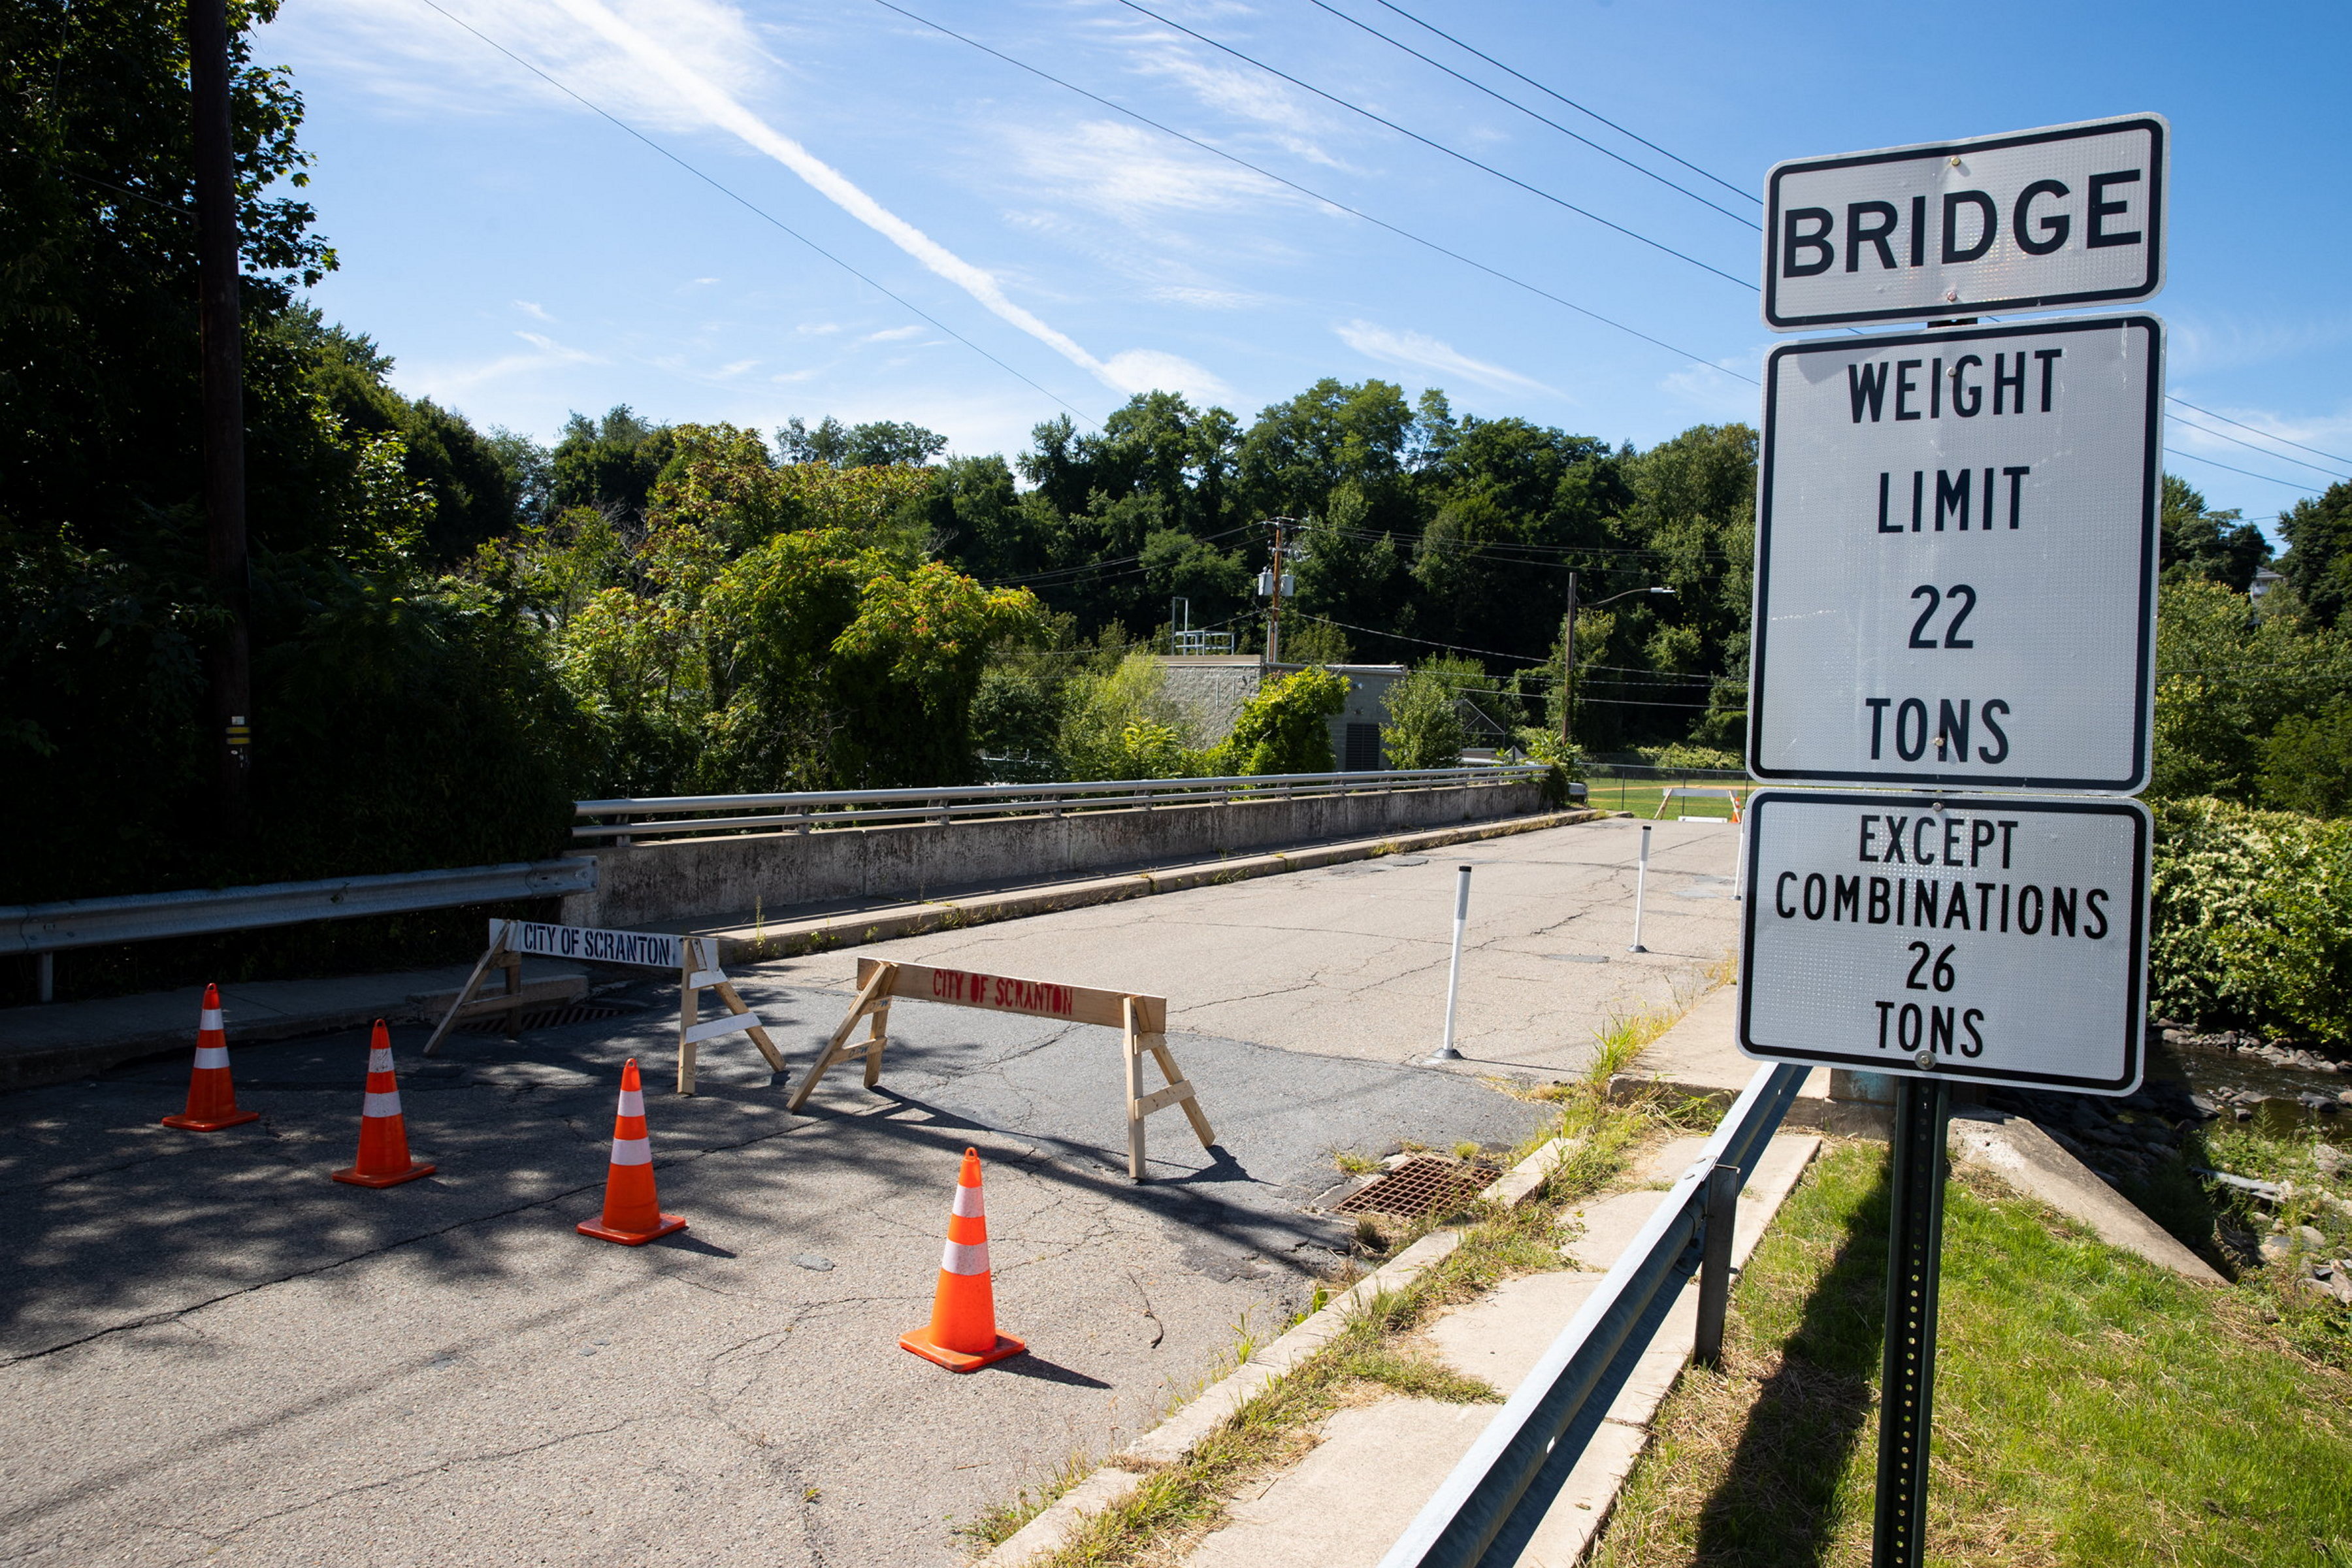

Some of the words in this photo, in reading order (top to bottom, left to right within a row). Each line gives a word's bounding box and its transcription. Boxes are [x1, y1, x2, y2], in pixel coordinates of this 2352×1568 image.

[1783, 169, 2142, 278] BRIDGE
[1848, 349, 2063, 423] WEIGHT
[1878, 466, 2029, 533] LIMIT
[1908, 585, 1976, 648] 22
[1865, 698, 2010, 764] TONS
[1859, 815, 2018, 868] EXCEPT
[1776, 872, 2109, 939] COMBINATIONS
[524, 924, 556, 952] CITY
[561, 928, 580, 955] OF
[585, 931, 670, 966] SCRANTON
[1906, 941, 1955, 992] 26
[933, 969, 964, 1000] CITY
[970, 973, 988, 1003] OF
[995, 977, 1073, 1015] SCRANTON
[1875, 1001, 1984, 1058] TONS
